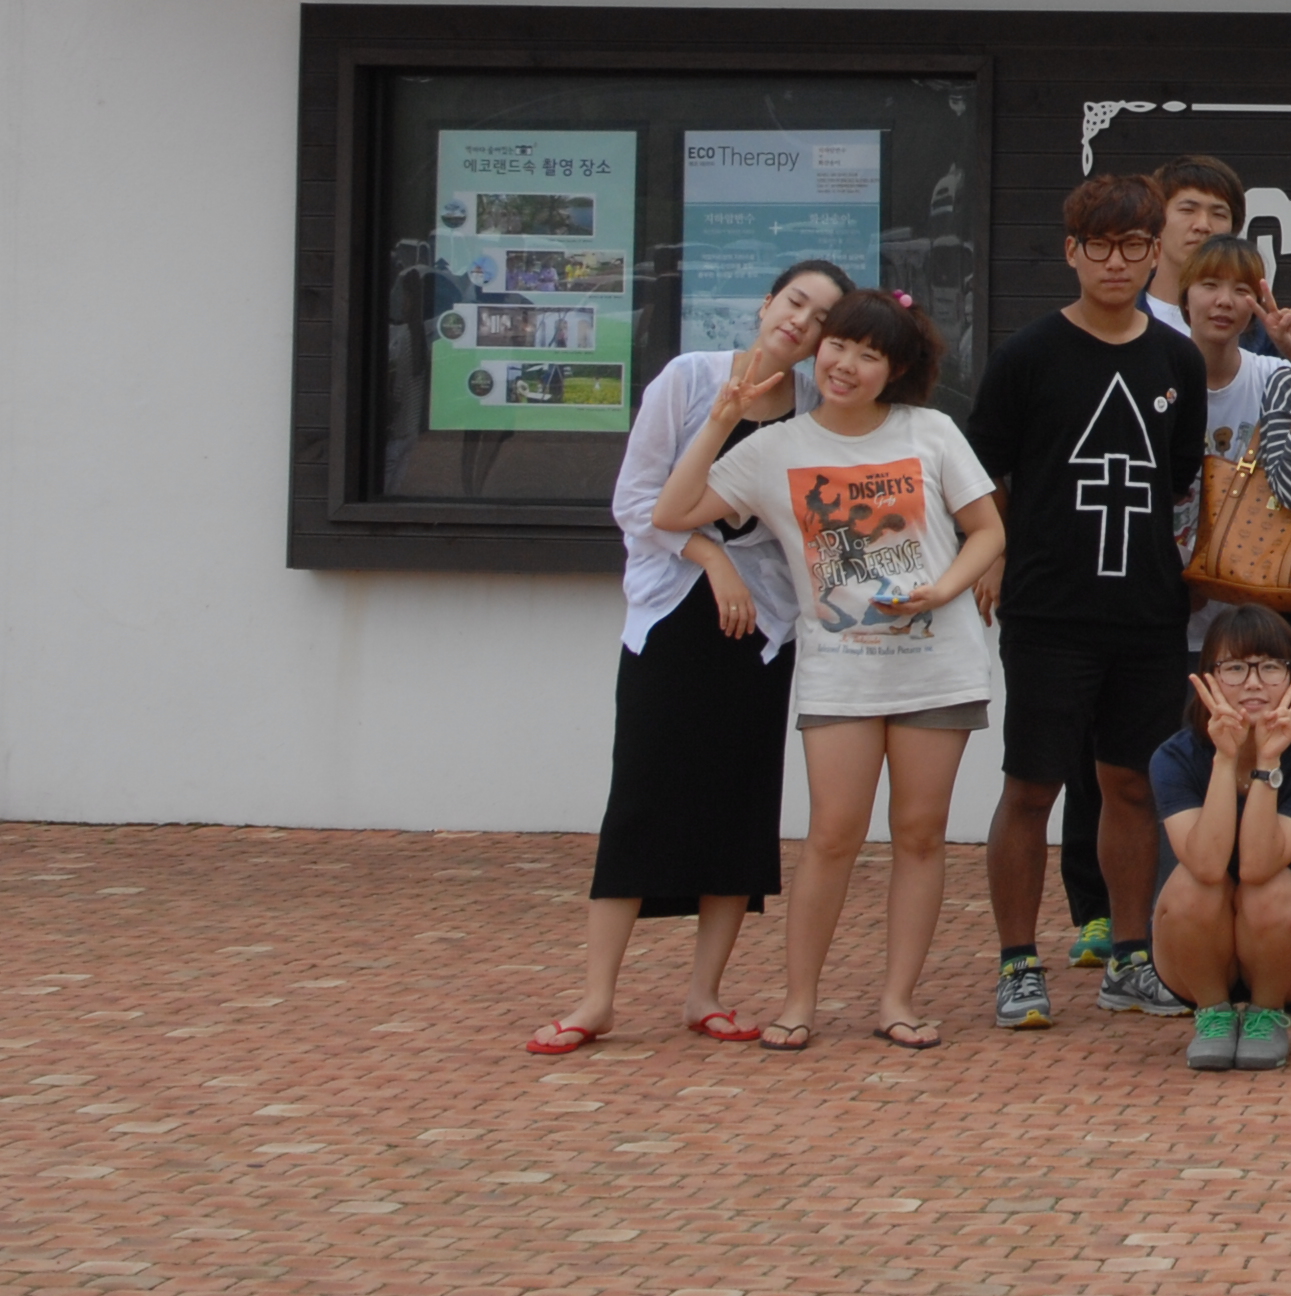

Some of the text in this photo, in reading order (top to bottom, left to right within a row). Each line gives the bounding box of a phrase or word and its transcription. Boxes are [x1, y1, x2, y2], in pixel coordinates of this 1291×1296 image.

[463, 158, 612, 177] 에코랜드속 촬영 장소
[687, 145, 800, 172] ECO Therapy
[848, 474, 915, 500] DISNEY'S
[865, 472, 889, 480] WALT
[815, 527, 850, 561] ART
[853, 536, 871, 550] OF
[812, 539, 924, 592] SELF DEFENSE
